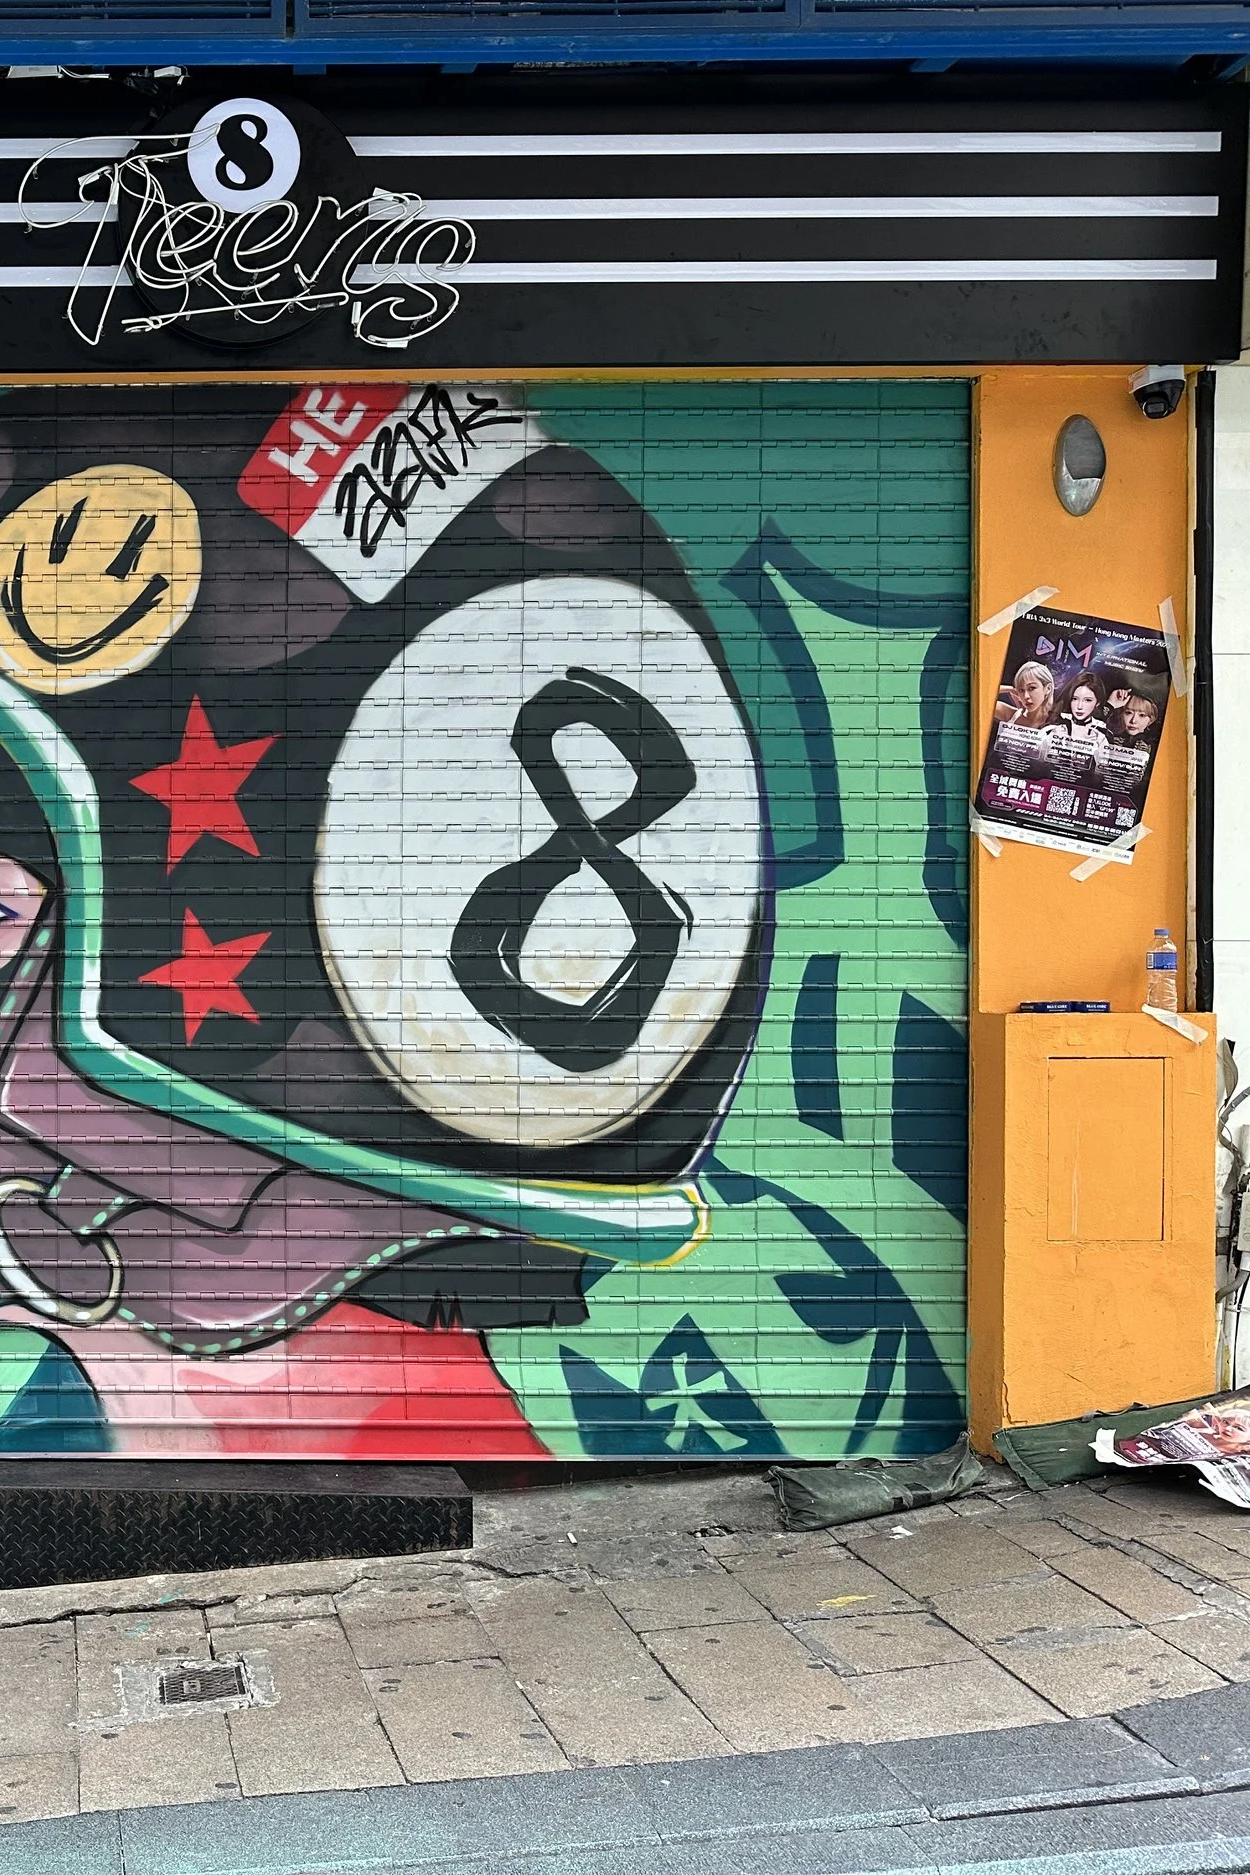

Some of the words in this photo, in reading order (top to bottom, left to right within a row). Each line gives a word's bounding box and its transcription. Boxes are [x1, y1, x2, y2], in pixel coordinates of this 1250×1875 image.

[214, 113, 274, 191] 8
[267, 388, 367, 487] HE
[448, 666, 698, 1073] 8
